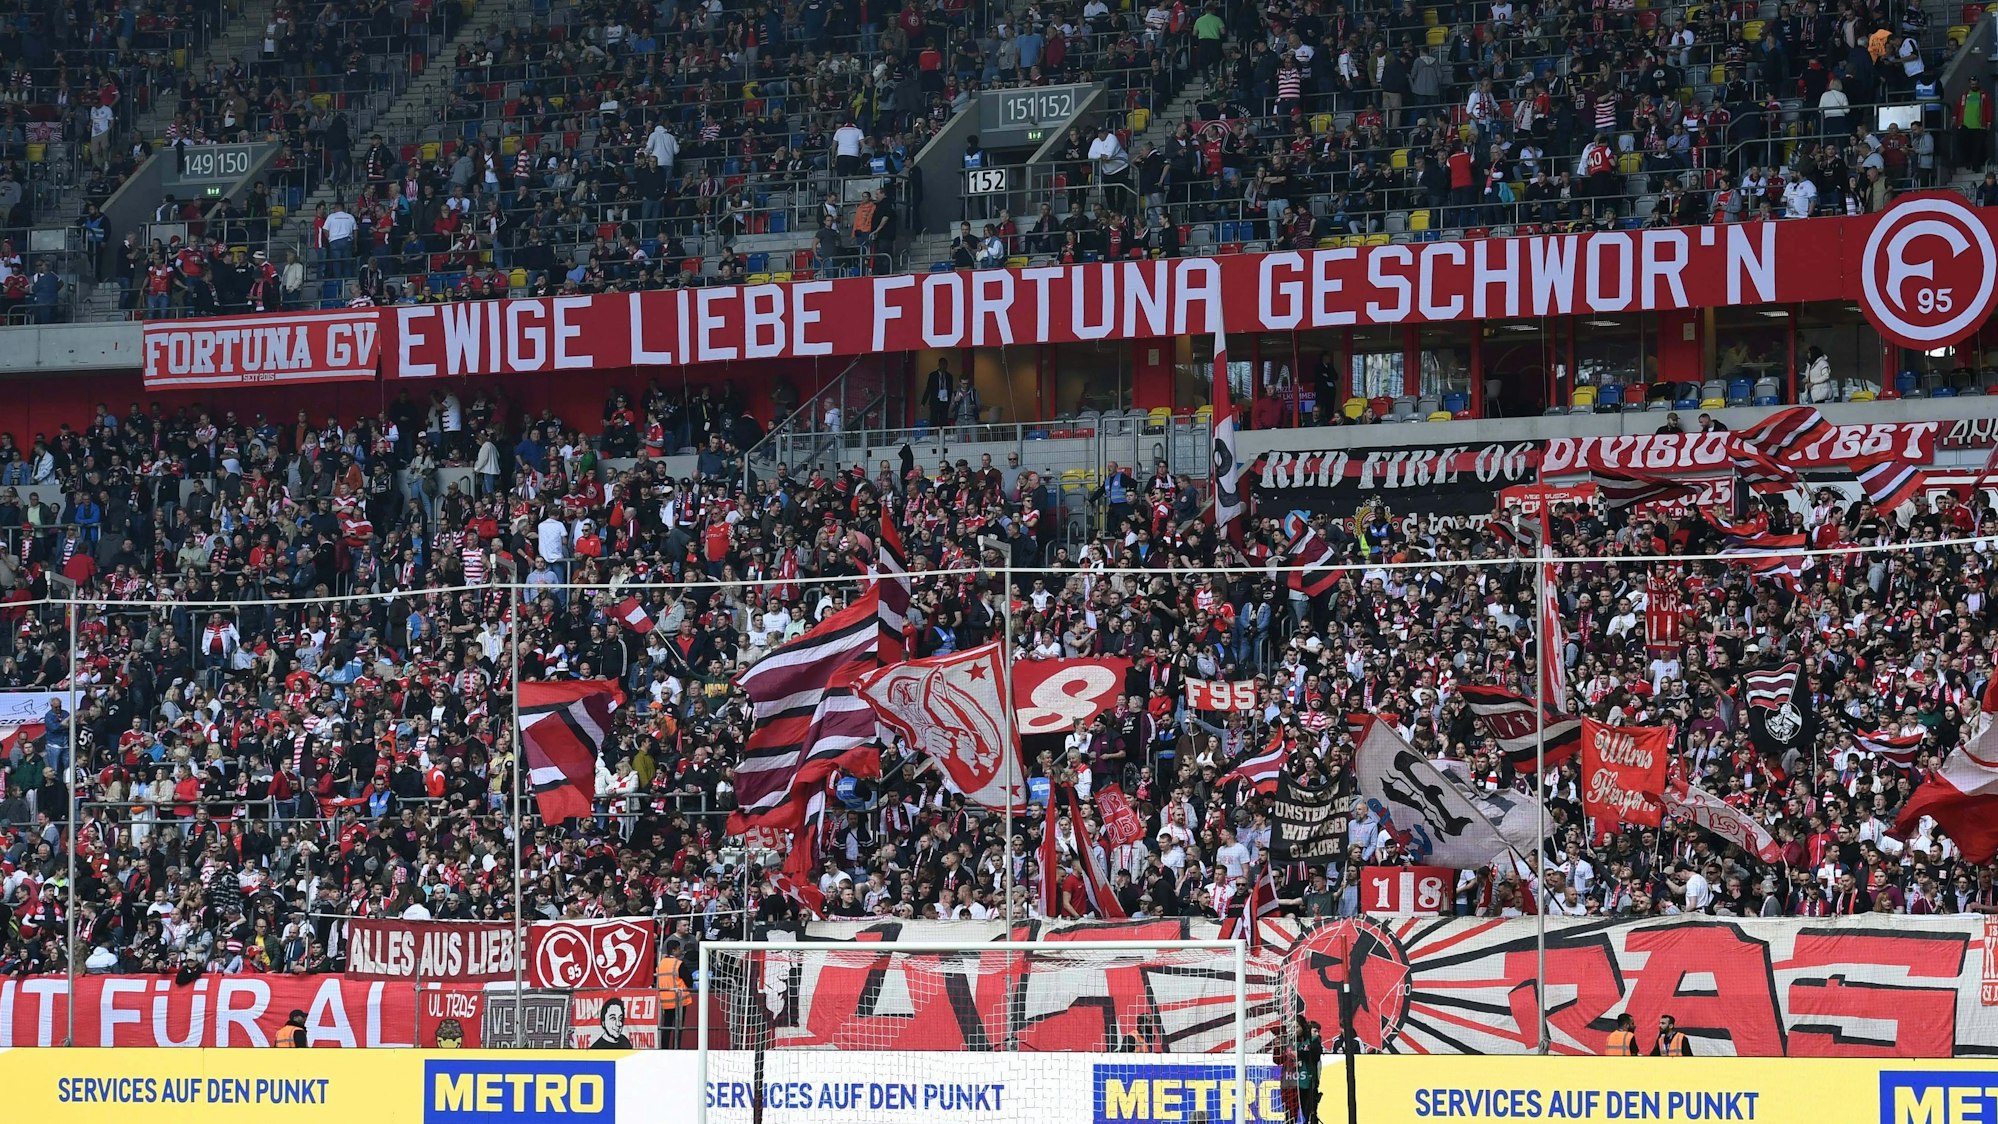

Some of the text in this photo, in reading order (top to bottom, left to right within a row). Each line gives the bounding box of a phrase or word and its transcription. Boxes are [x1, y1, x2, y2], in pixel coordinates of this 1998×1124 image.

[1008, 97, 1034, 120] 151
[1040, 95, 1070, 117] 152
[184, 154, 213, 175] 149
[218, 152, 247, 173] 150
[1588, 151, 1602, 167] 40
[971, 171, 1004, 191] 152
[398, 222, 1776, 377] EWIGE LIEBE FORTUNA GESCHWOR'N
[1917, 288, 1952, 314] 95
[145, 323, 377, 376] FORTUNA GV
[1542, 432, 1762, 472] DIVISIO
[1260, 451, 1349, 488] RED
[1358, 446, 1465, 489] FIRE
[1017, 665, 1116, 733] 8
[1187, 677, 1256, 709] F95
[1289, 838, 1340, 858] GLAUBE
[348, 930, 415, 976] ALLES
[420, 929, 462, 976] AUS
[567, 965, 581, 979] 95
[100, 979, 271, 1047] FÜR
[428, 994, 477, 1018] ULTRAS
[492, 1007, 561, 1034] VECHIO
[58, 1078, 329, 1104] SERVICES AUF DEN PUNKT
[435, 1073, 604, 1113] METRO
[706, 1082, 1004, 1111] SERVICES AUF DEN PUNKT
[1415, 1089, 1759, 1120] SERVICES AUF DEN PUNKT
